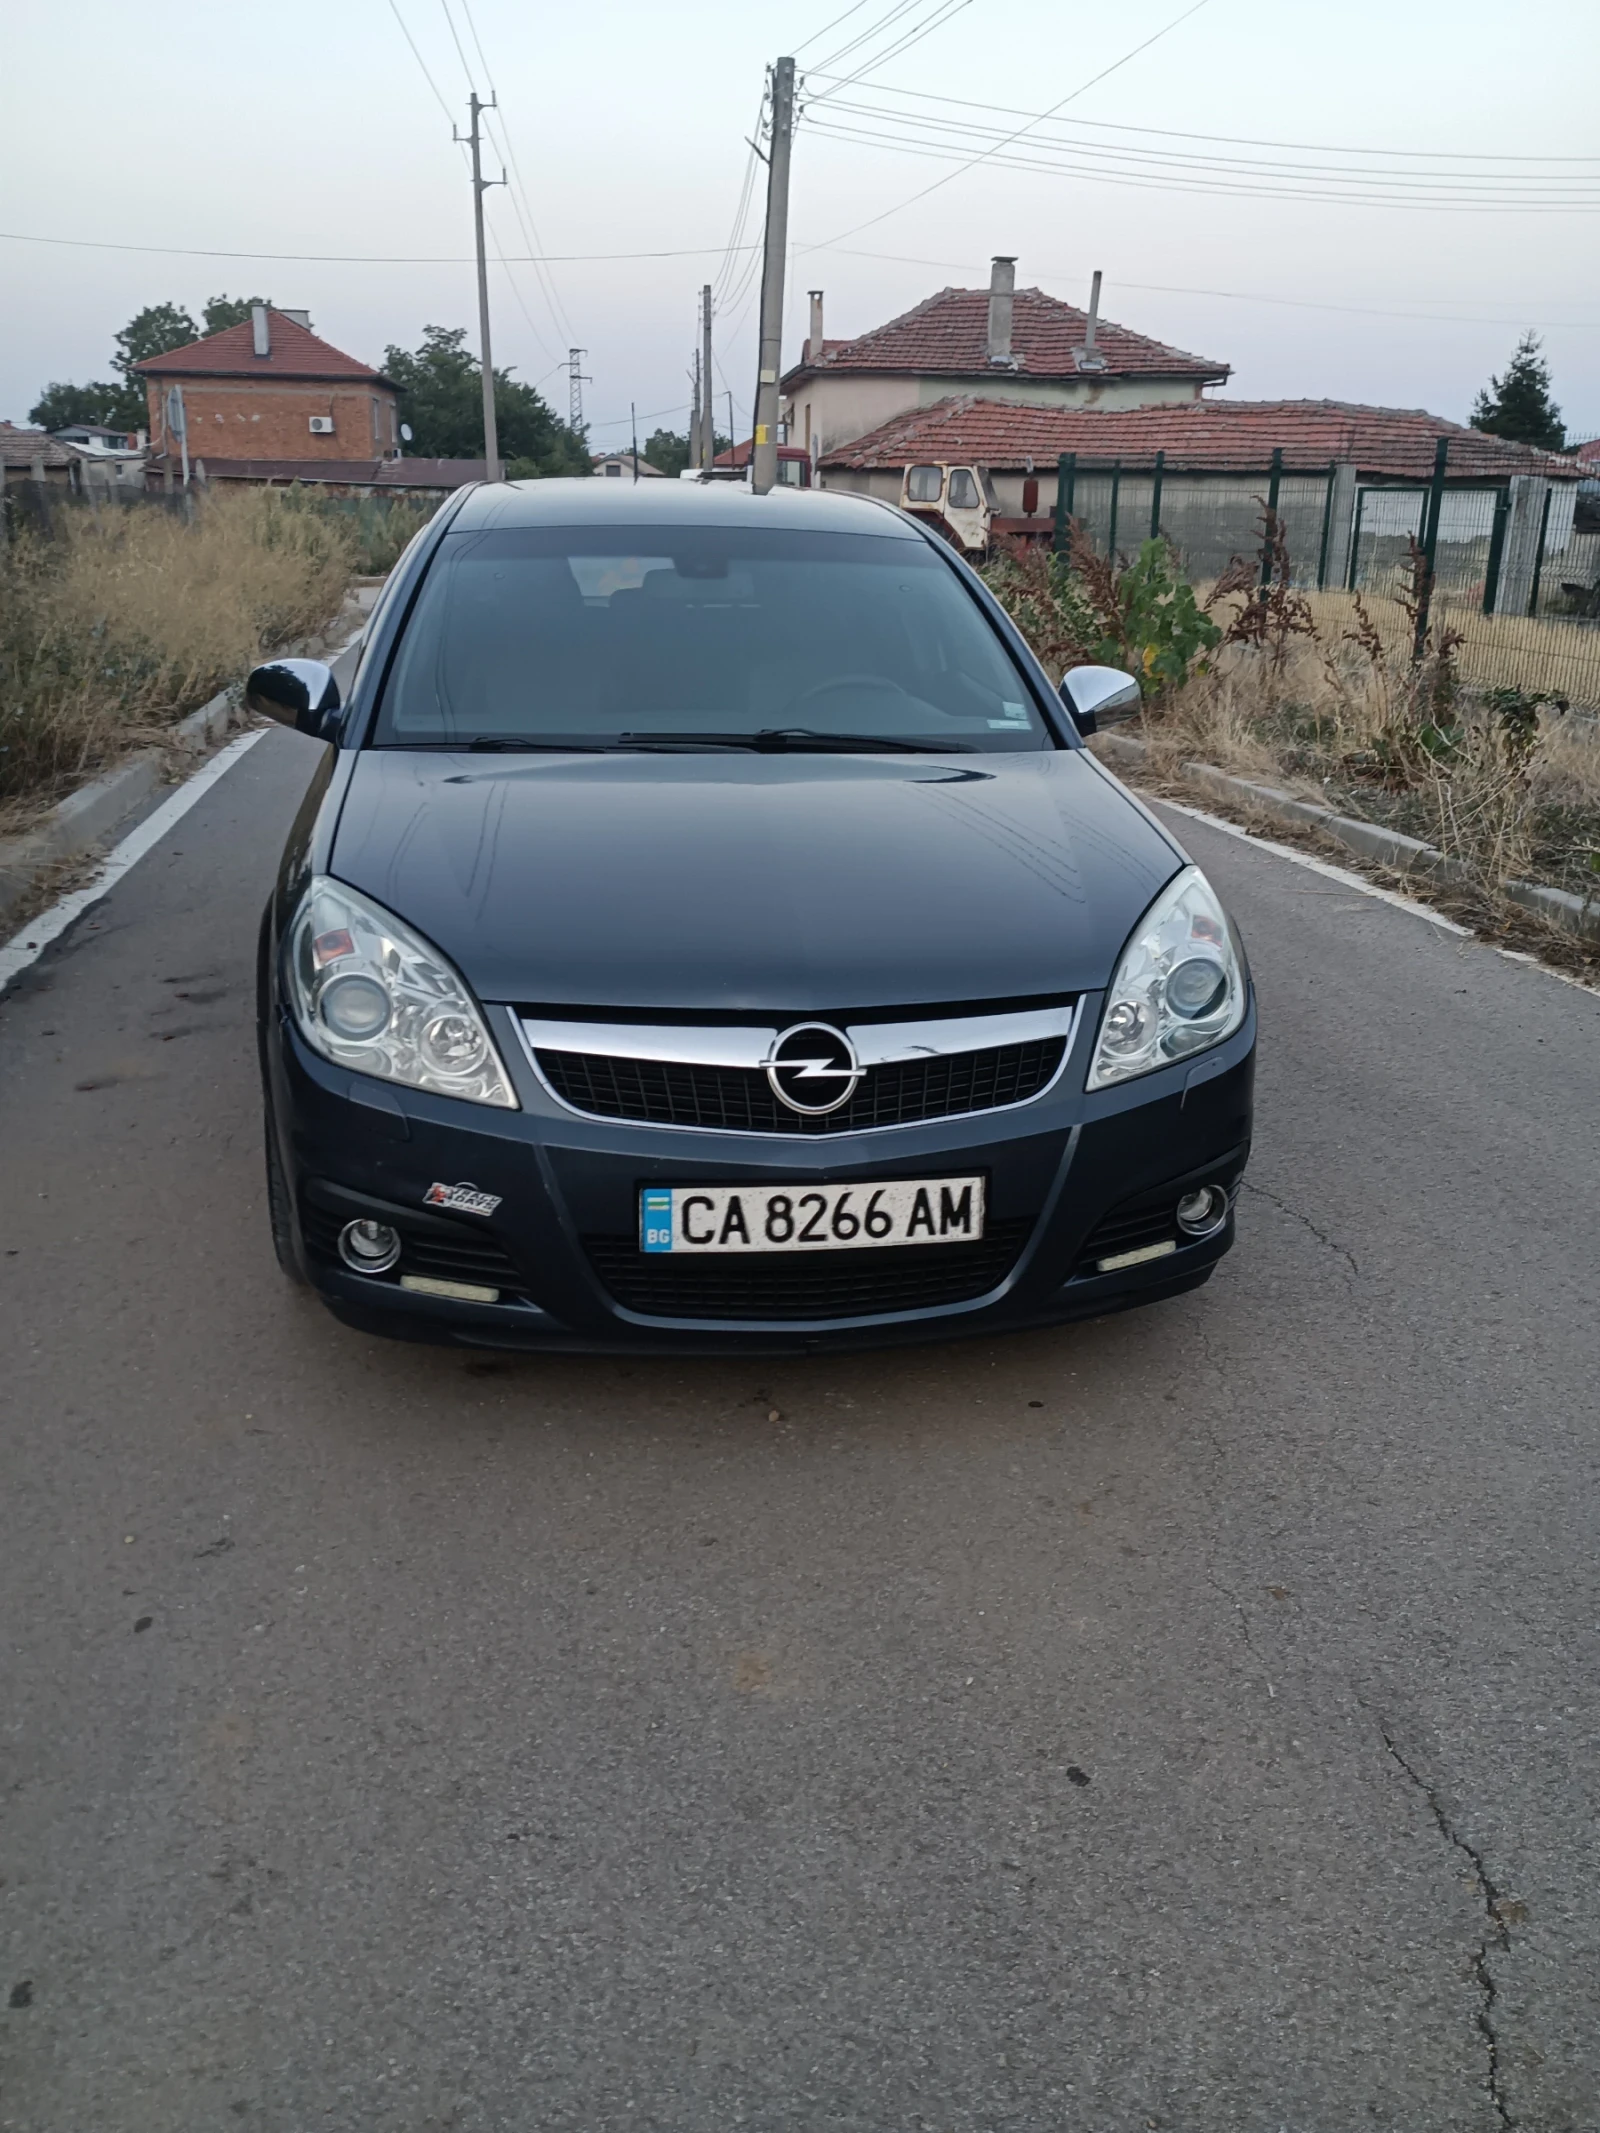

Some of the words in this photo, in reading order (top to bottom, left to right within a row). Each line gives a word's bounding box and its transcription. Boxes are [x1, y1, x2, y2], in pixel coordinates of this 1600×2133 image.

[681, 1195, 750, 1245] CA
[764, 1189, 893, 1243] 8266
[905, 1185, 973, 1238] AM
[647, 1229, 670, 1244] BG
